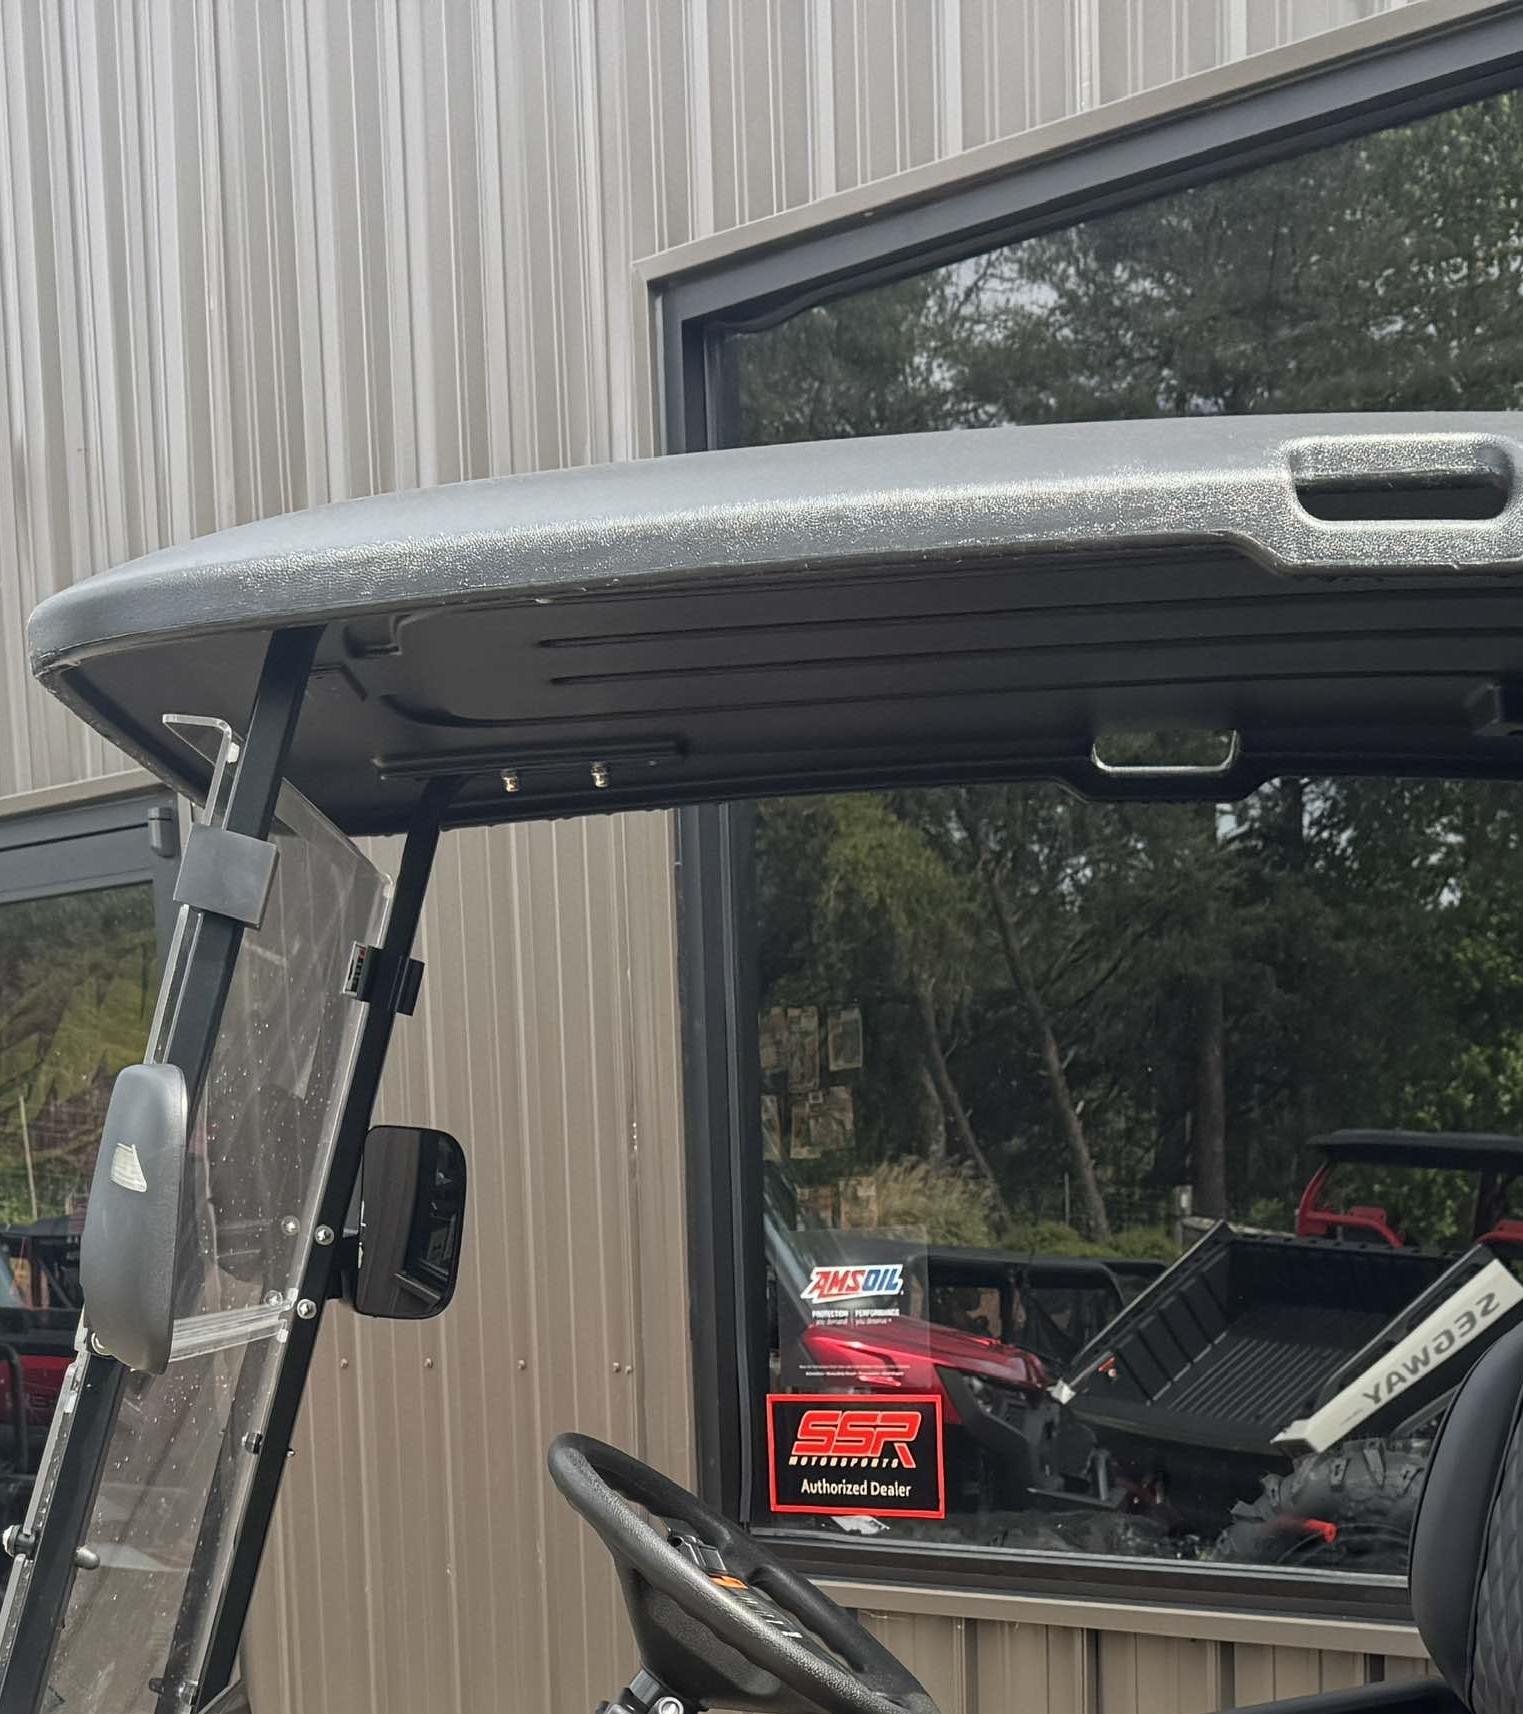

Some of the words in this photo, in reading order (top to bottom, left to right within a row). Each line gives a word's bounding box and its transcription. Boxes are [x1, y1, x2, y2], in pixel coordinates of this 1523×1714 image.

[805, 1266, 901, 1301] AMSOIL
[791, 1410, 922, 1468] SSR
[788, 1456, 899, 1469] MOTORSPORTS
[801, 1478, 868, 1497] Authorized
[870, 1480, 912, 1498] Dealer
